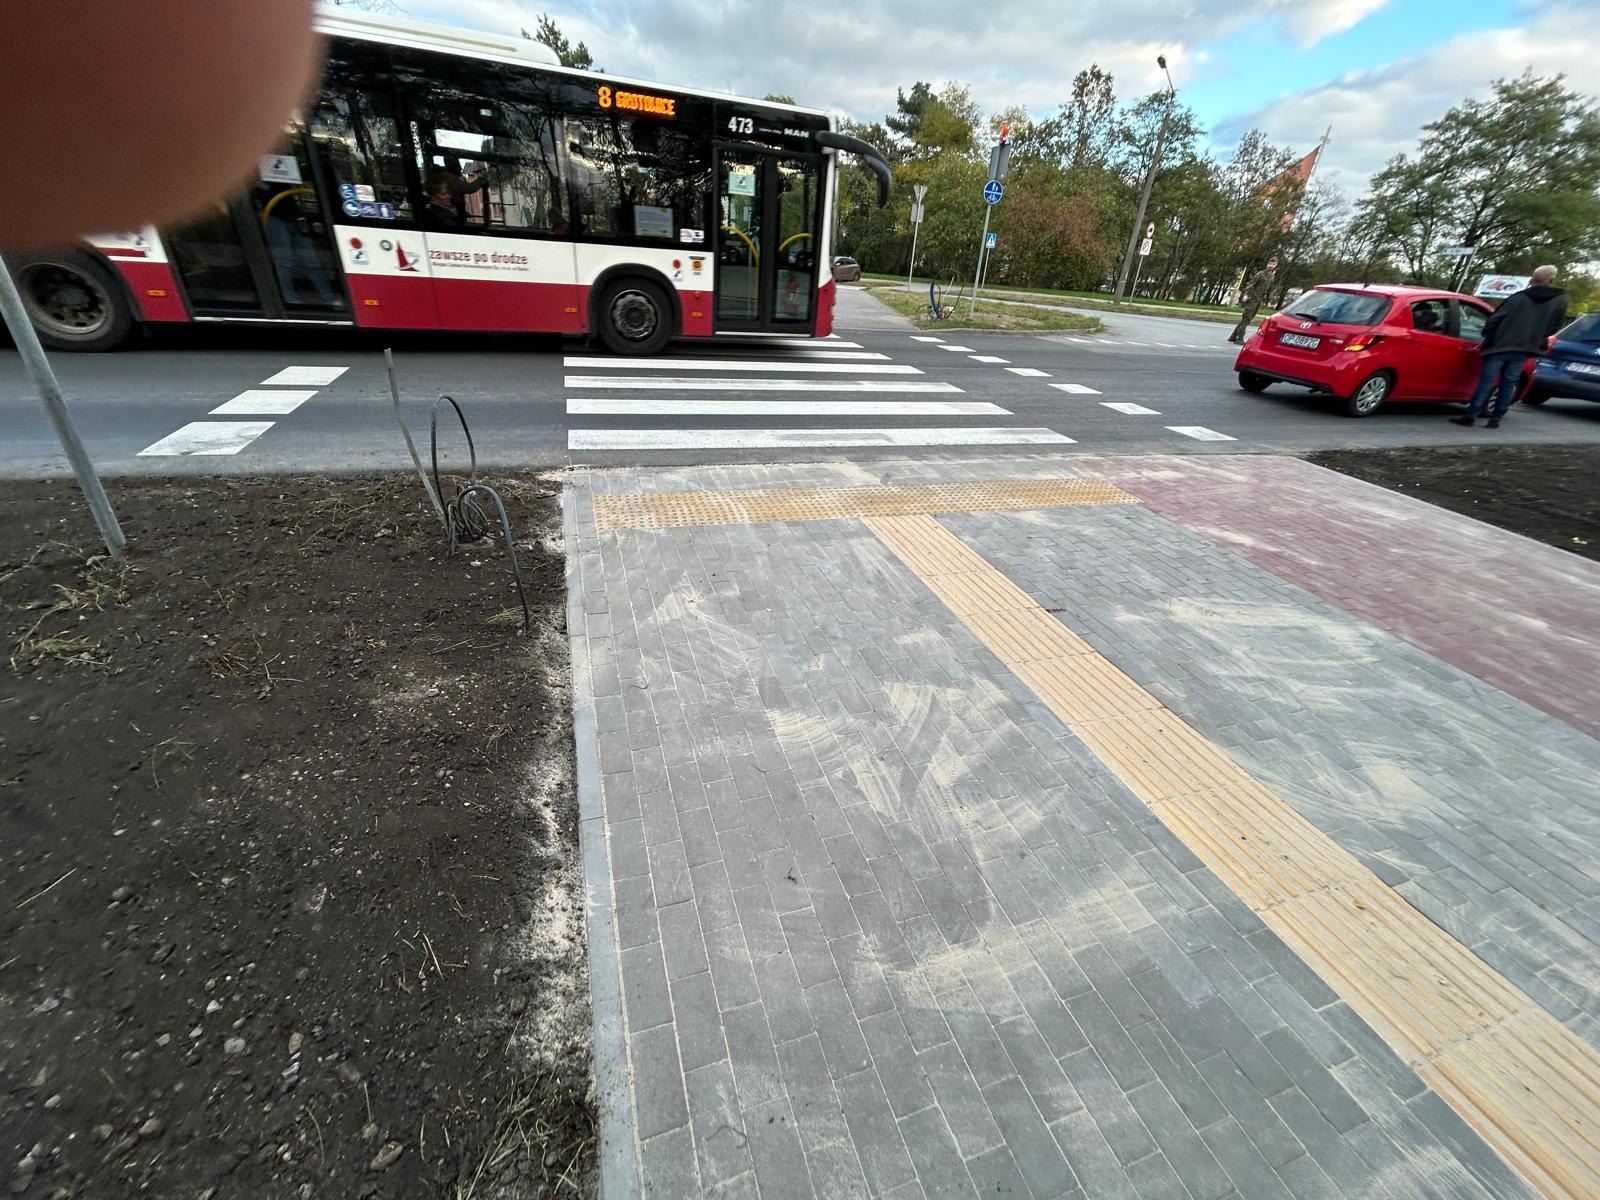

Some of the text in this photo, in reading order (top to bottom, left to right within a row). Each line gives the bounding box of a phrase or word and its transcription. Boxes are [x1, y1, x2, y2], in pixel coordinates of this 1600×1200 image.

[598, 86, 612, 108] 8
[728, 116, 754, 134] 473
[783, 127, 810, 138] MAN
[428, 250, 528, 264] zawsze po drodze
